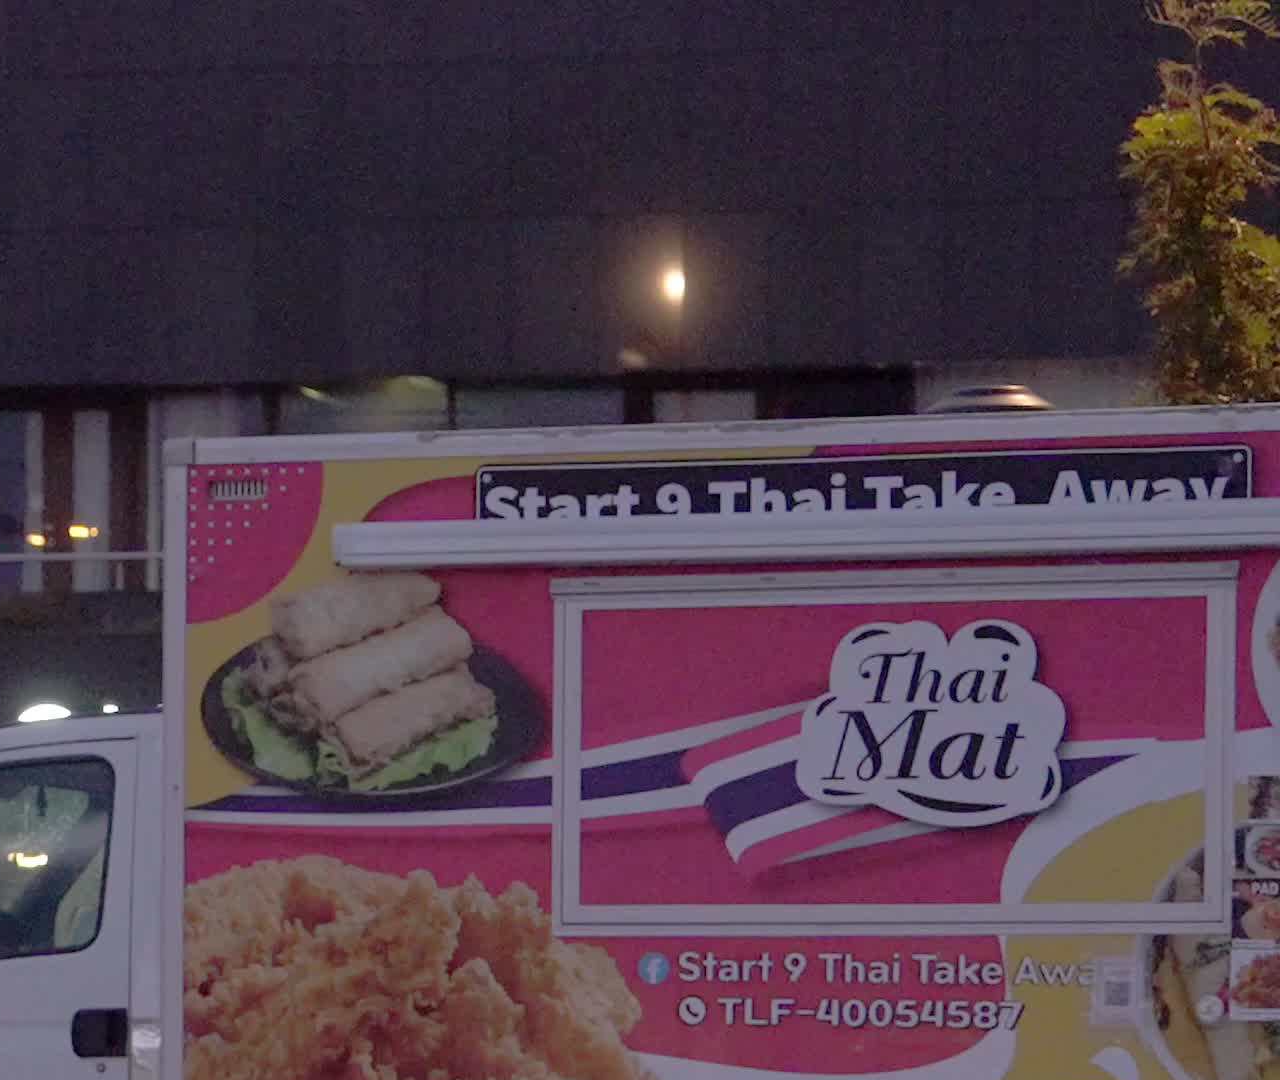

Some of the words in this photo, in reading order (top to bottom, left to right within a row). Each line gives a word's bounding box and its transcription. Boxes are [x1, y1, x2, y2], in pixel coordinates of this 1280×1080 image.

[485, 484, 640, 518] Start
[655, 482, 692, 514] 9
[707, 472, 848, 512] Thai
[863, 470, 1017, 509] Take
[1048, 470, 1231, 503] Away
[858, 648, 1009, 704] Thai
[821, 709, 1025, 782] Mat
[677, 951, 774, 983] Start
[782, 952, 809, 983] 9
[818, 952, 901, 985] Thai
[911, 953, 1004, 986] Take
[716, 998, 1025, 1031] TLF-40054587
